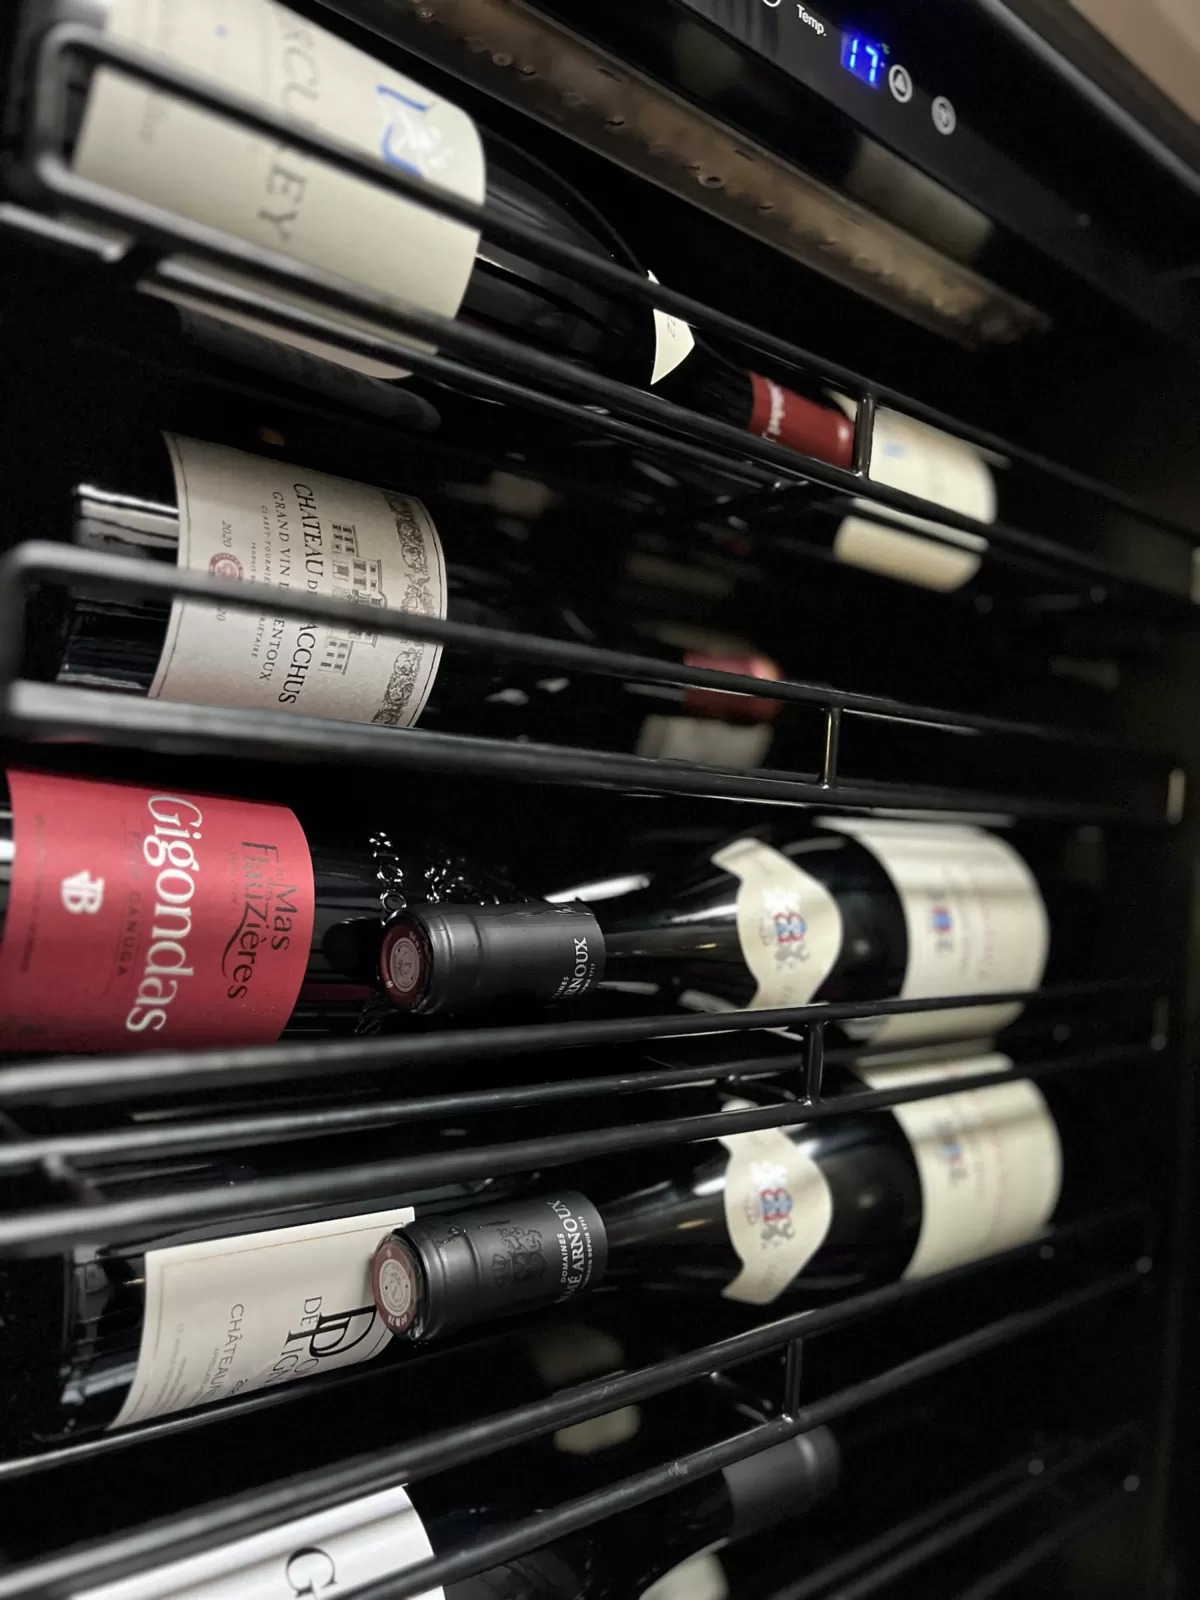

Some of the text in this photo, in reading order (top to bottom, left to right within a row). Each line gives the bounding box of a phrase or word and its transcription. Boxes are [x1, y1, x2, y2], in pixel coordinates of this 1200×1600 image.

[796, 4, 827, 36] Temp.
[849, 39, 879, 83] 17
[221, 520, 232, 548] 2020
[272, 491, 290, 543] GRAND
[293, 483, 324, 577] CHATEAU
[278, 547, 291, 577] VIN
[216, 607, 227, 622] 20
[251, 617, 265, 658] RIÉTAIRE
[259, 617, 286, 682] ENTOUX
[278, 621, 317, 704] ACCHUS
[125, 794, 203, 1032] Gigondas
[270, 882, 298, 951] Mas
[563, 937, 589, 998] RNOUX
[547, 1199, 586, 1272] ARNOUX
[556, 1232, 569, 1284] DOMAINES
[299, 1296, 322, 1326] DE
